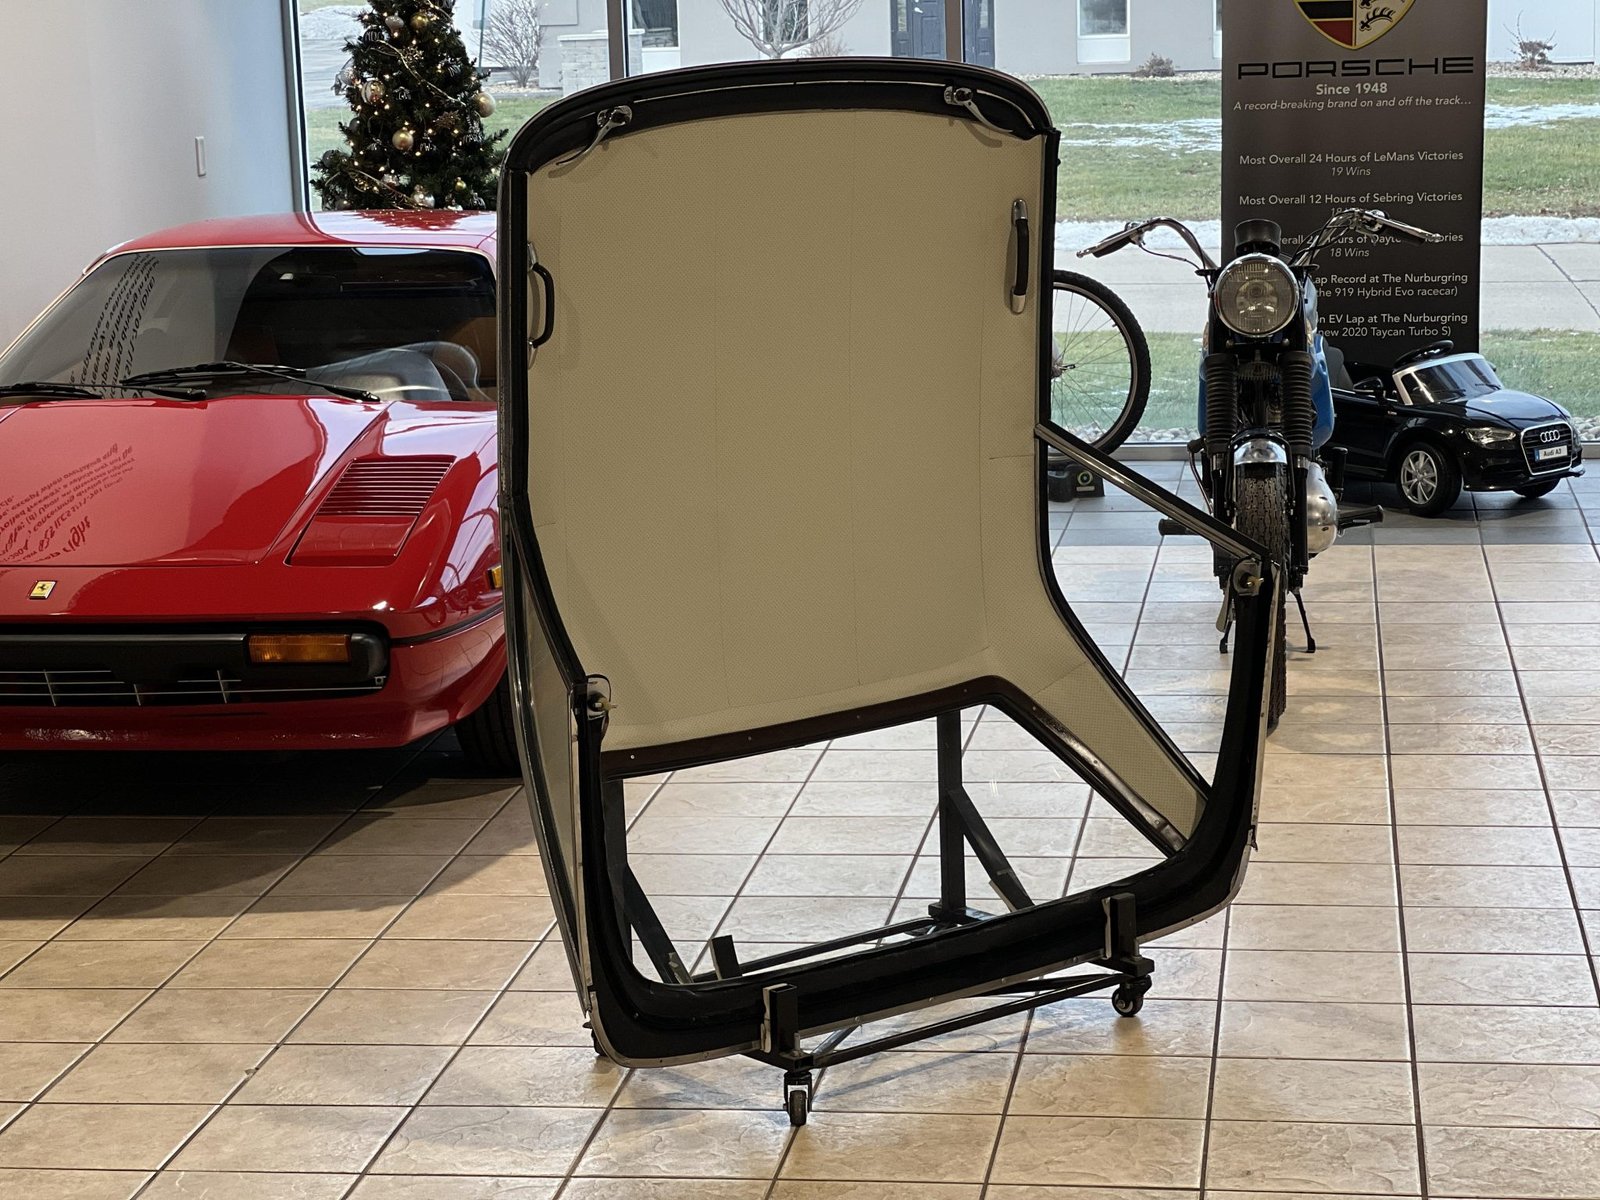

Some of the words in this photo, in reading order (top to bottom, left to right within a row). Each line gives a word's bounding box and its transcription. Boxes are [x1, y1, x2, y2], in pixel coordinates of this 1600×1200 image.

[1238, 56, 1474, 80] PORSCHE
[1316, 83, 1350, 95] Since
[1355, 82, 1388, 95] 1948
[1234, 102, 1242, 111] A
[1244, 99, 1324, 112] record-breaking
[1327, 98, 1358, 109] brand
[1360, 99, 1373, 108] on
[1376, 97, 1396, 107] and
[1398, 96, 1413, 107] off
[1415, 96, 1432, 106] the
[1239, 155, 1266, 165] Most
[1269, 153, 1307, 165] Overall
[1309, 153, 1323, 164] 24
[1325, 152, 1358, 163] Hours
[1360, 151, 1372, 162] of
[1374, 151, 1415, 162] LeMans
[1417, 150, 1464, 161] Victories
[1331, 166, 1343, 177] 19
[1346, 166, 1371, 176] Wins
[1239, 195, 1266, 206] Most
[1269, 194, 1306, 205] Overall
[1309, 194, 1322, 204] 12
[1325, 193, 1357, 204] Hours
[1359, 192, 1371, 203] of
[1373, 192, 1414, 205] Sebring
[1416, 191, 1463, 202] Victories
[1356, 234, 1368, 243] of
[1331, 248, 1341, 257] 18
[1344, 248, 1370, 258] Wins
[1331, 274, 1367, 284] Record
[1370, 275, 1379, 283] at
[1382, 273, 1402, 283] The
[1405, 273, 1468, 285] Nurburgring
[1334, 287, 1354, 297] 919
[1358, 287, 1392, 299] Hybrid
[1395, 287, 1414, 296] Evo
[1417, 286, 1458, 297] racecar)
[1329, 314, 1343, 323] EV
[1346, 314, 1365, 326] Lap
[1368, 314, 1378, 323] at
[1381, 313, 1401, 323] The
[1403, 312, 1468, 324] Nurburgring
[1342, 327, 1368, 337] 2020
[1370, 327, 1405, 339] Taycan
[1408, 326, 1438, 336] Turbo
[1441, 326, 1451, 337] S)
[1543, 449, 1554, 457] Audi
